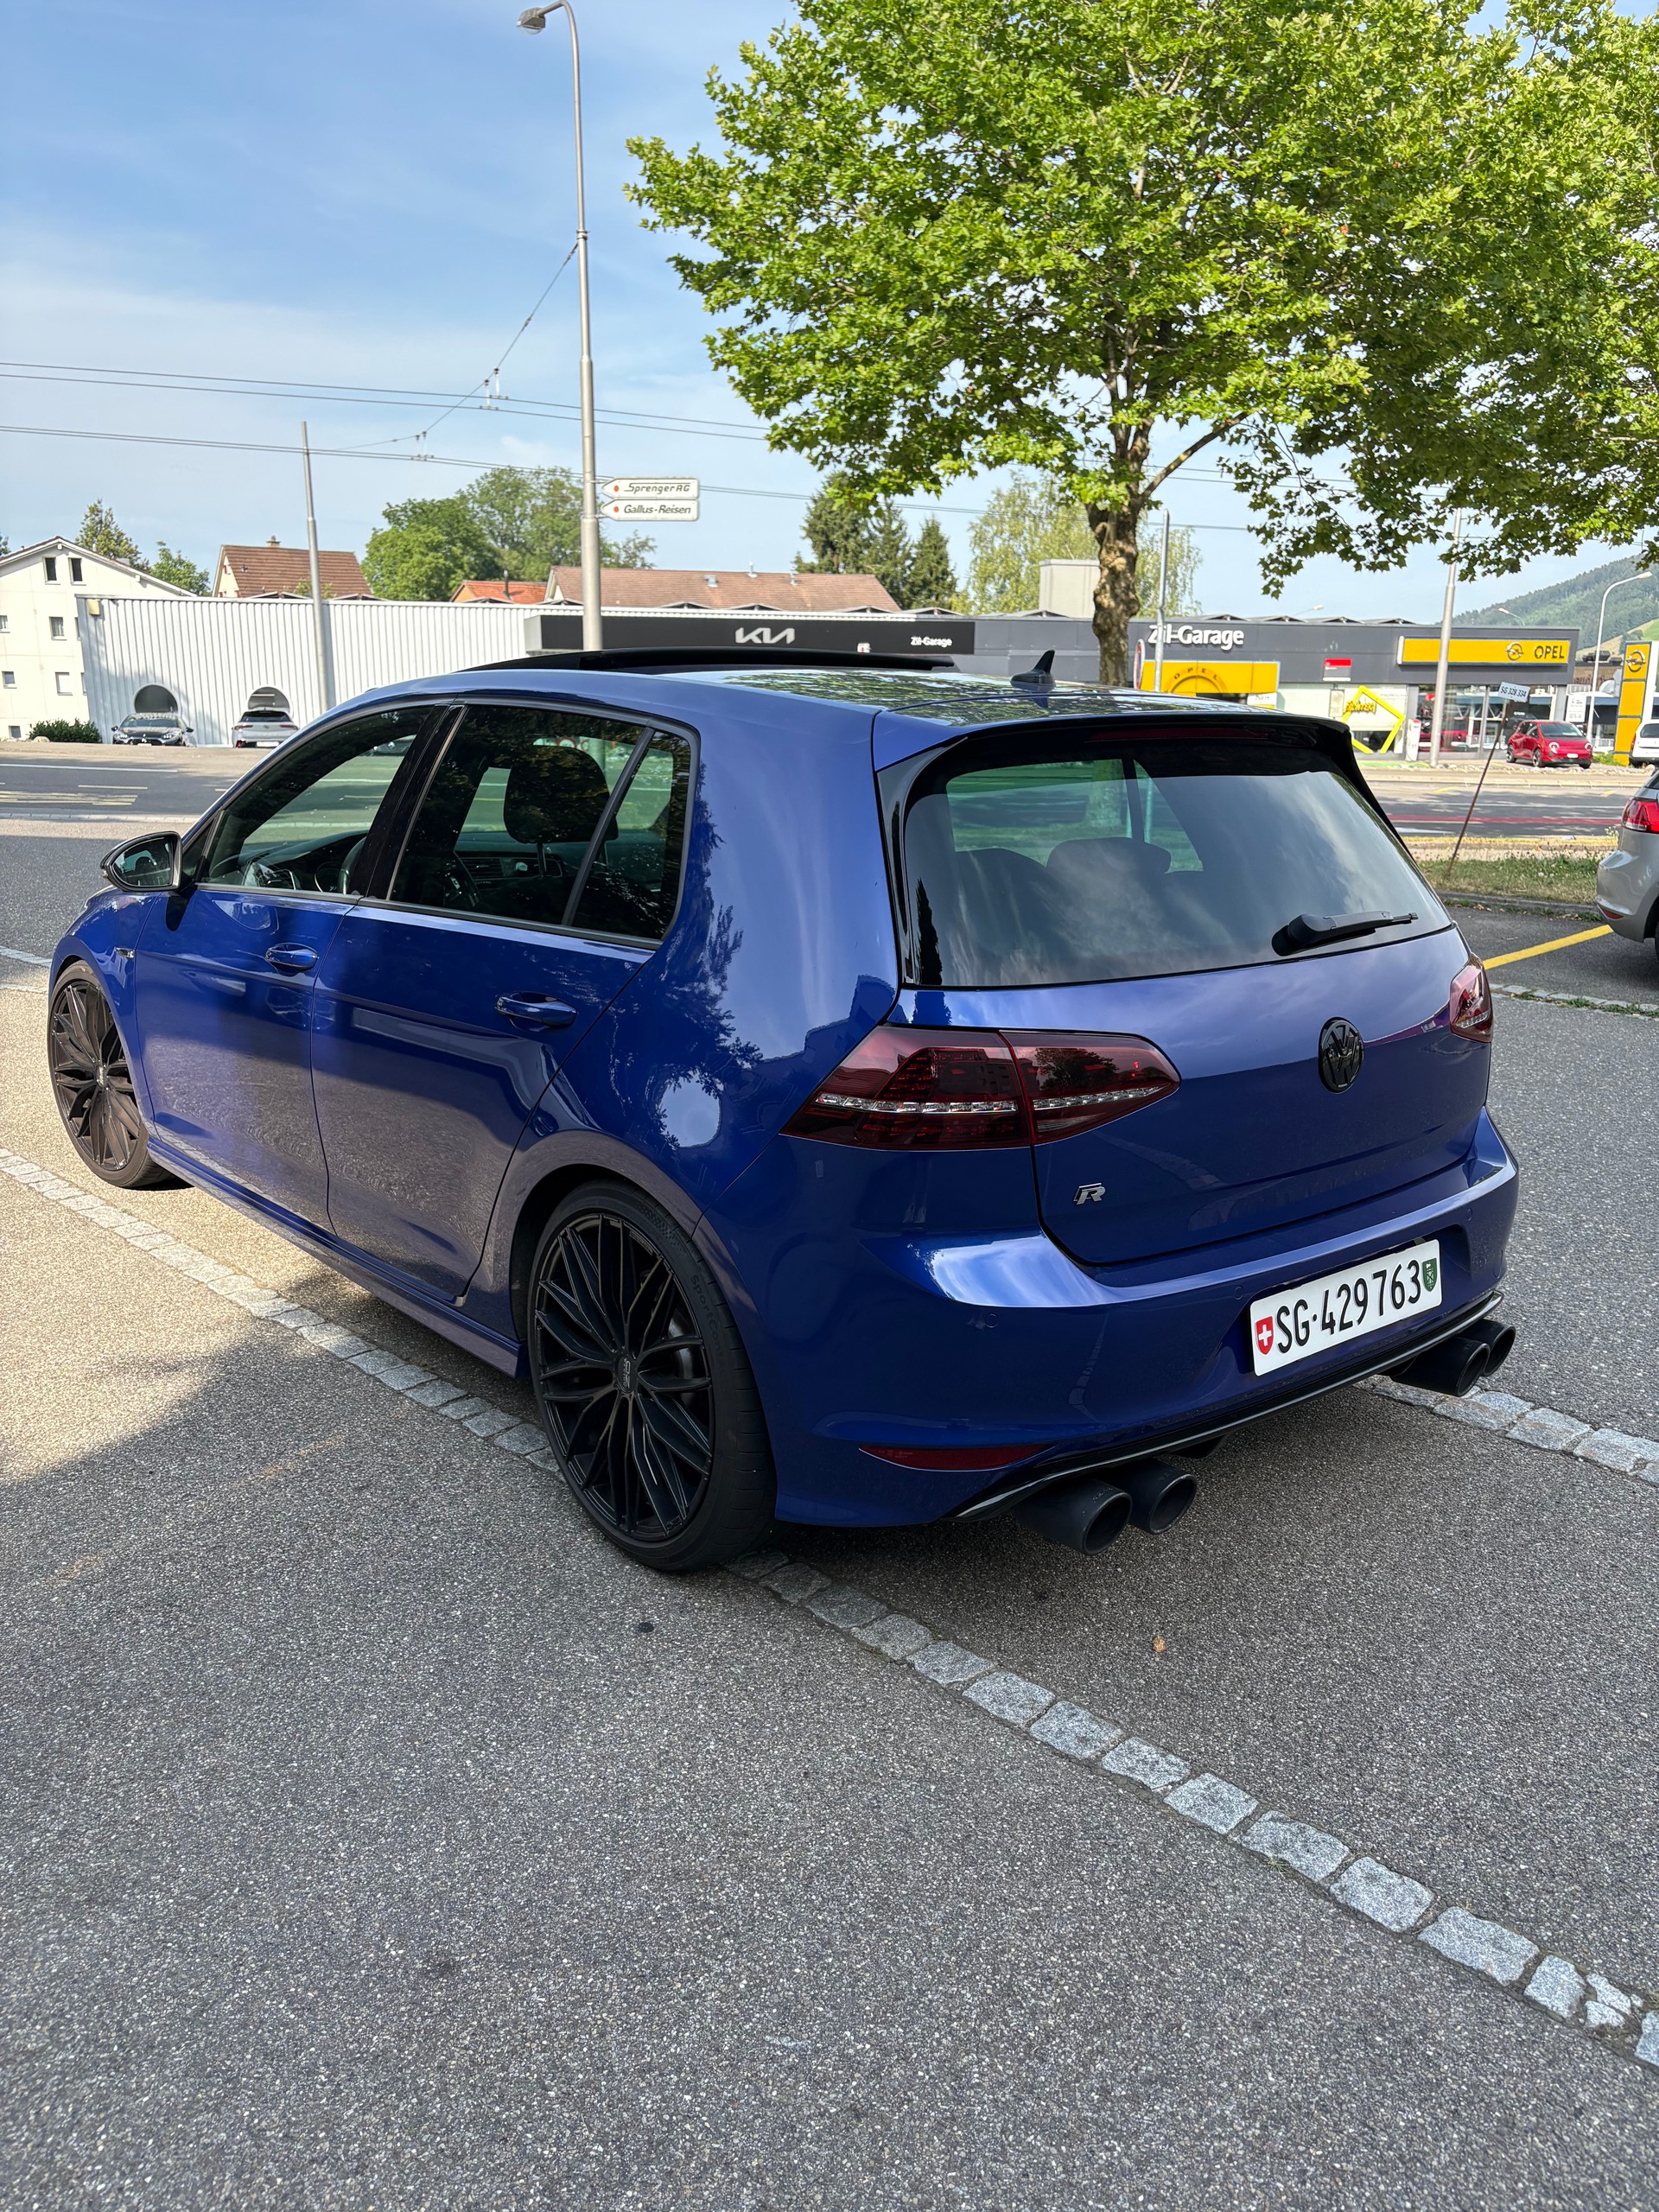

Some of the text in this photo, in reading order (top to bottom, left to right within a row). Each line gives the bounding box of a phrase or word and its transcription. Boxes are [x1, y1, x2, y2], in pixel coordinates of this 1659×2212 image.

[624, 482, 674, 494] Sprenger
[734, 627, 795, 645] KIA
[1534, 645, 1565, 658] OPEL
[1073, 1183, 1106, 1205] R
